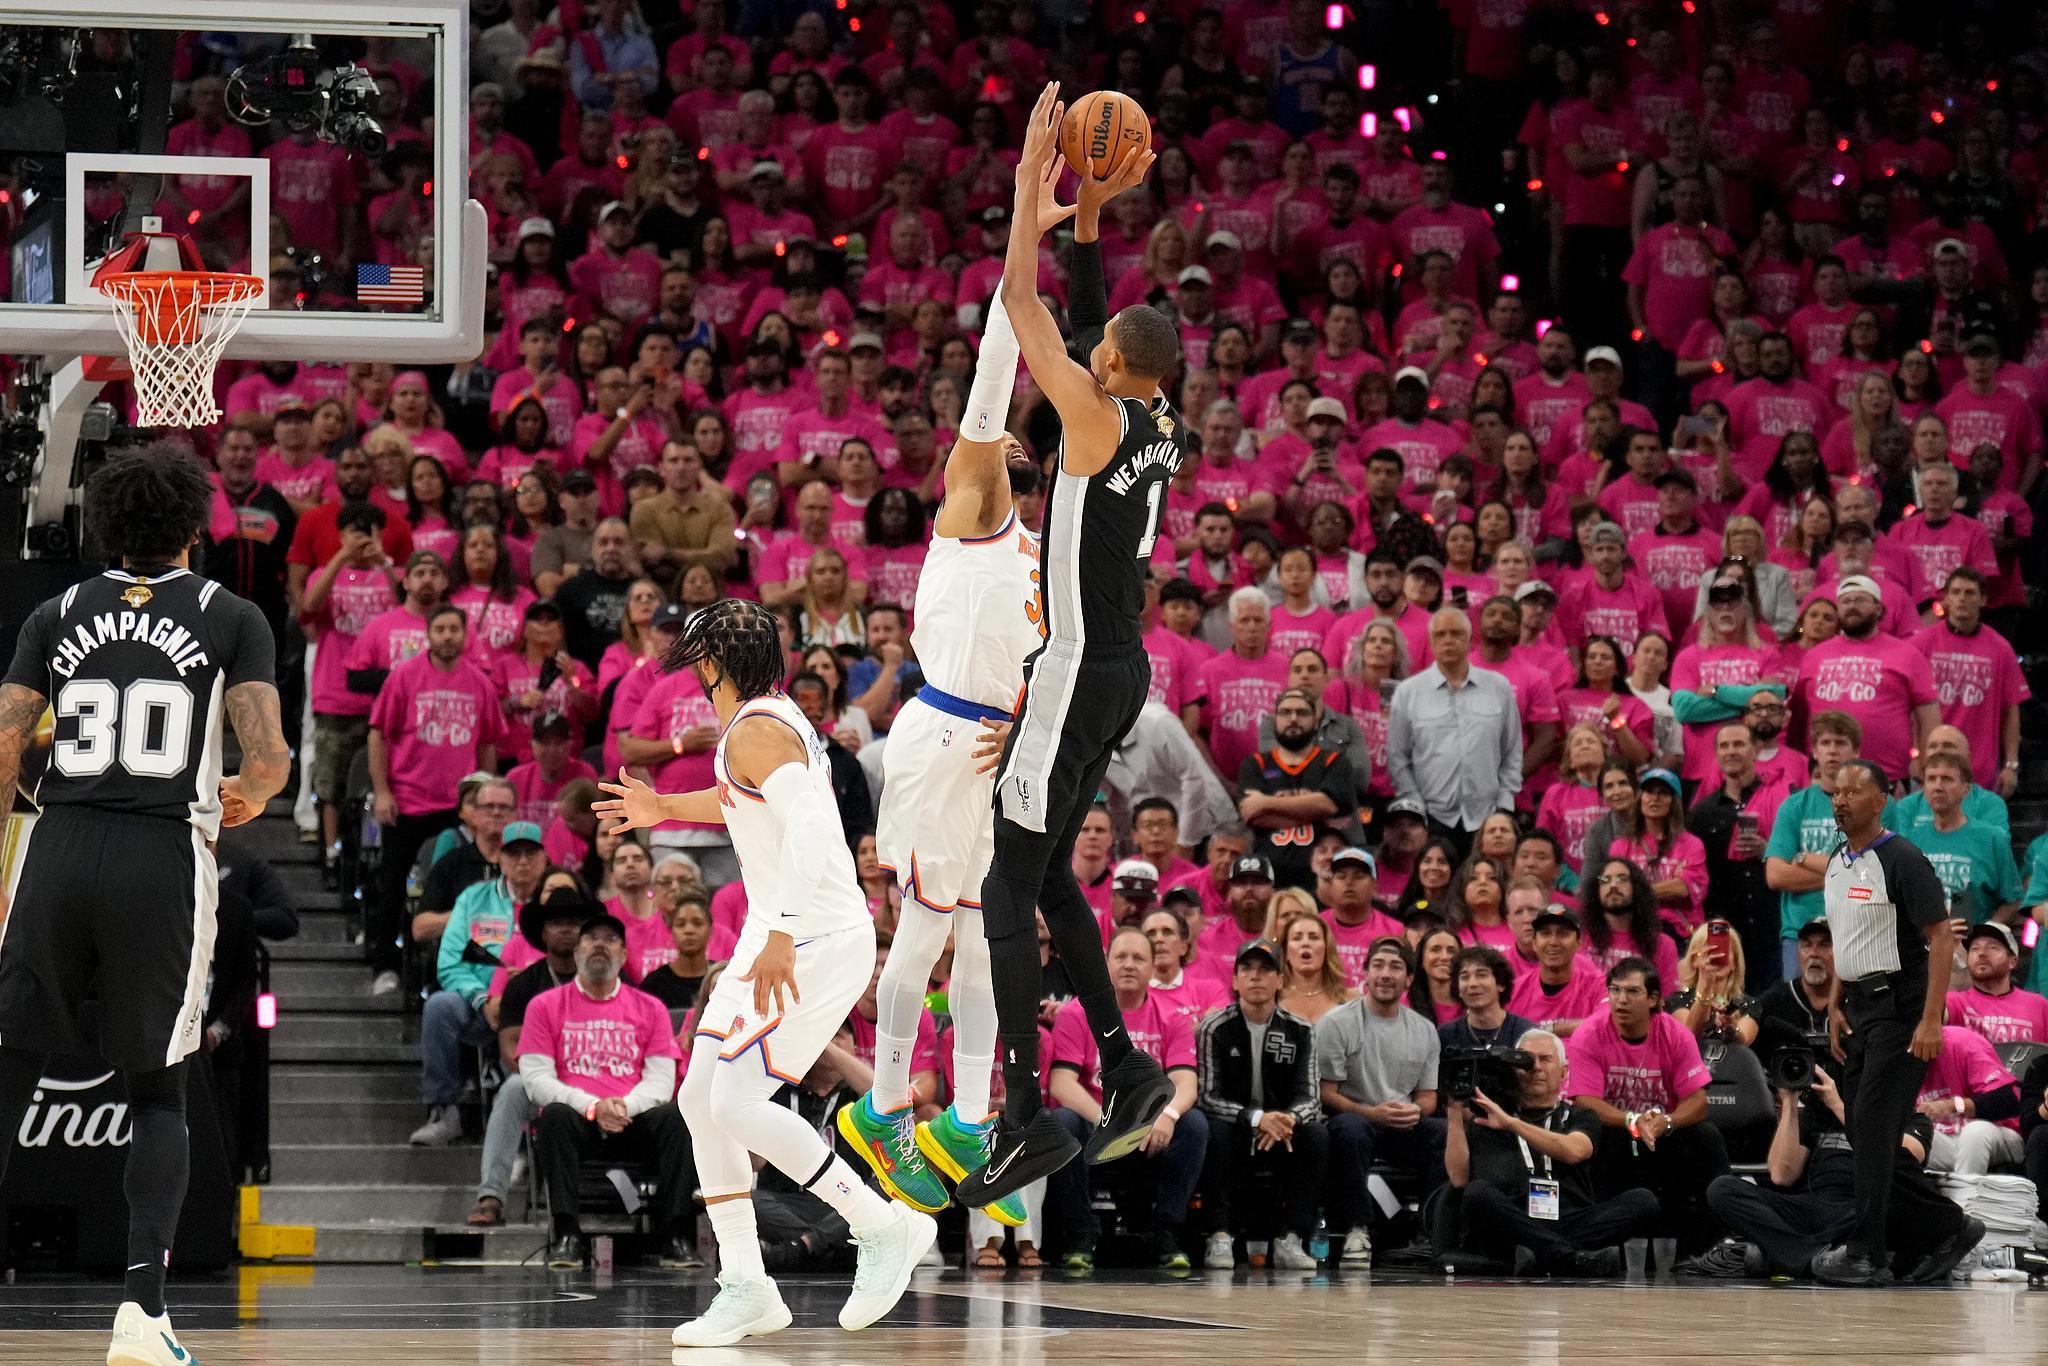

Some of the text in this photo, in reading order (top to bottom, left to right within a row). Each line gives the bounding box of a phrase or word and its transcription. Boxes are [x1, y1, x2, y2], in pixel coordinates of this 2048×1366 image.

[1090, 101, 1114, 158] Wilson
[1136, 480, 1163, 559] 1
[52, 611, 209, 679] CHAMPAGNIE
[55, 678, 195, 779] 30
[562, 1028, 640, 1060] FINALS
[586, 1019, 614, 1030] 2026
[18, 1069, 133, 1147] ina
